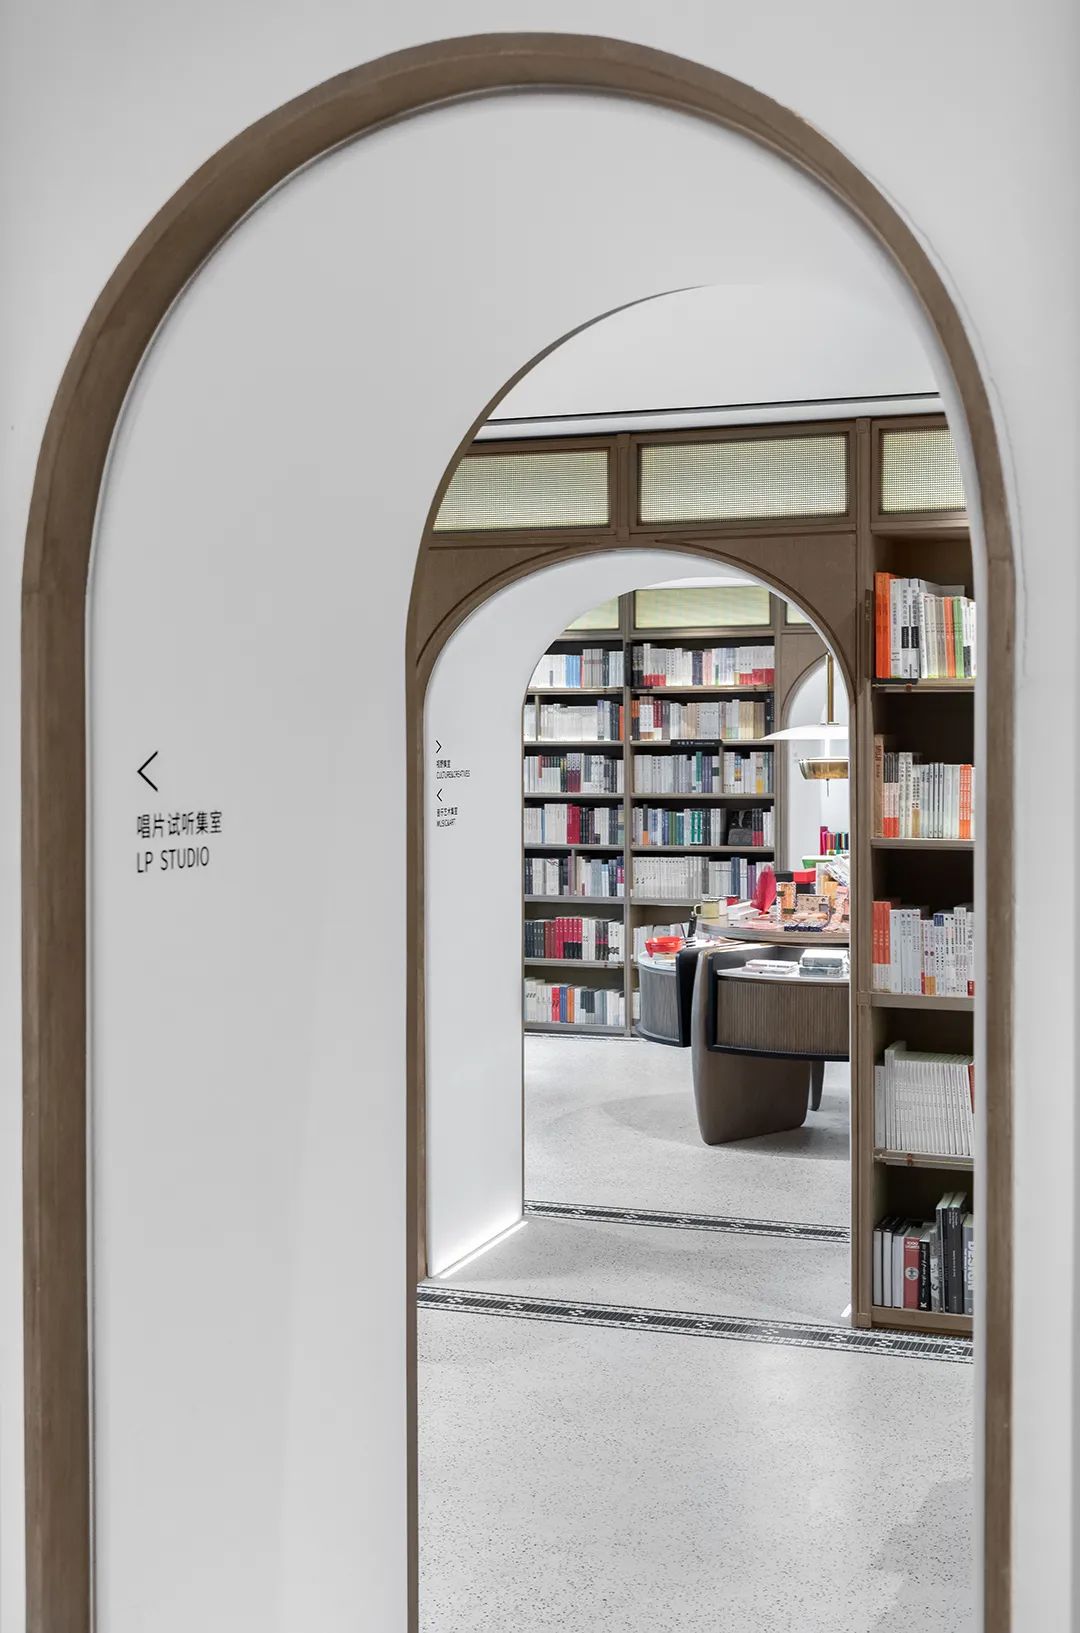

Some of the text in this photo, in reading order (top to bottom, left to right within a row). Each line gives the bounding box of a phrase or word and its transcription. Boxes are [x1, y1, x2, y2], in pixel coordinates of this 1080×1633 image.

[136, 810, 222, 839] 唱片试听集室
[136, 846, 210, 874] LP STUDIO
